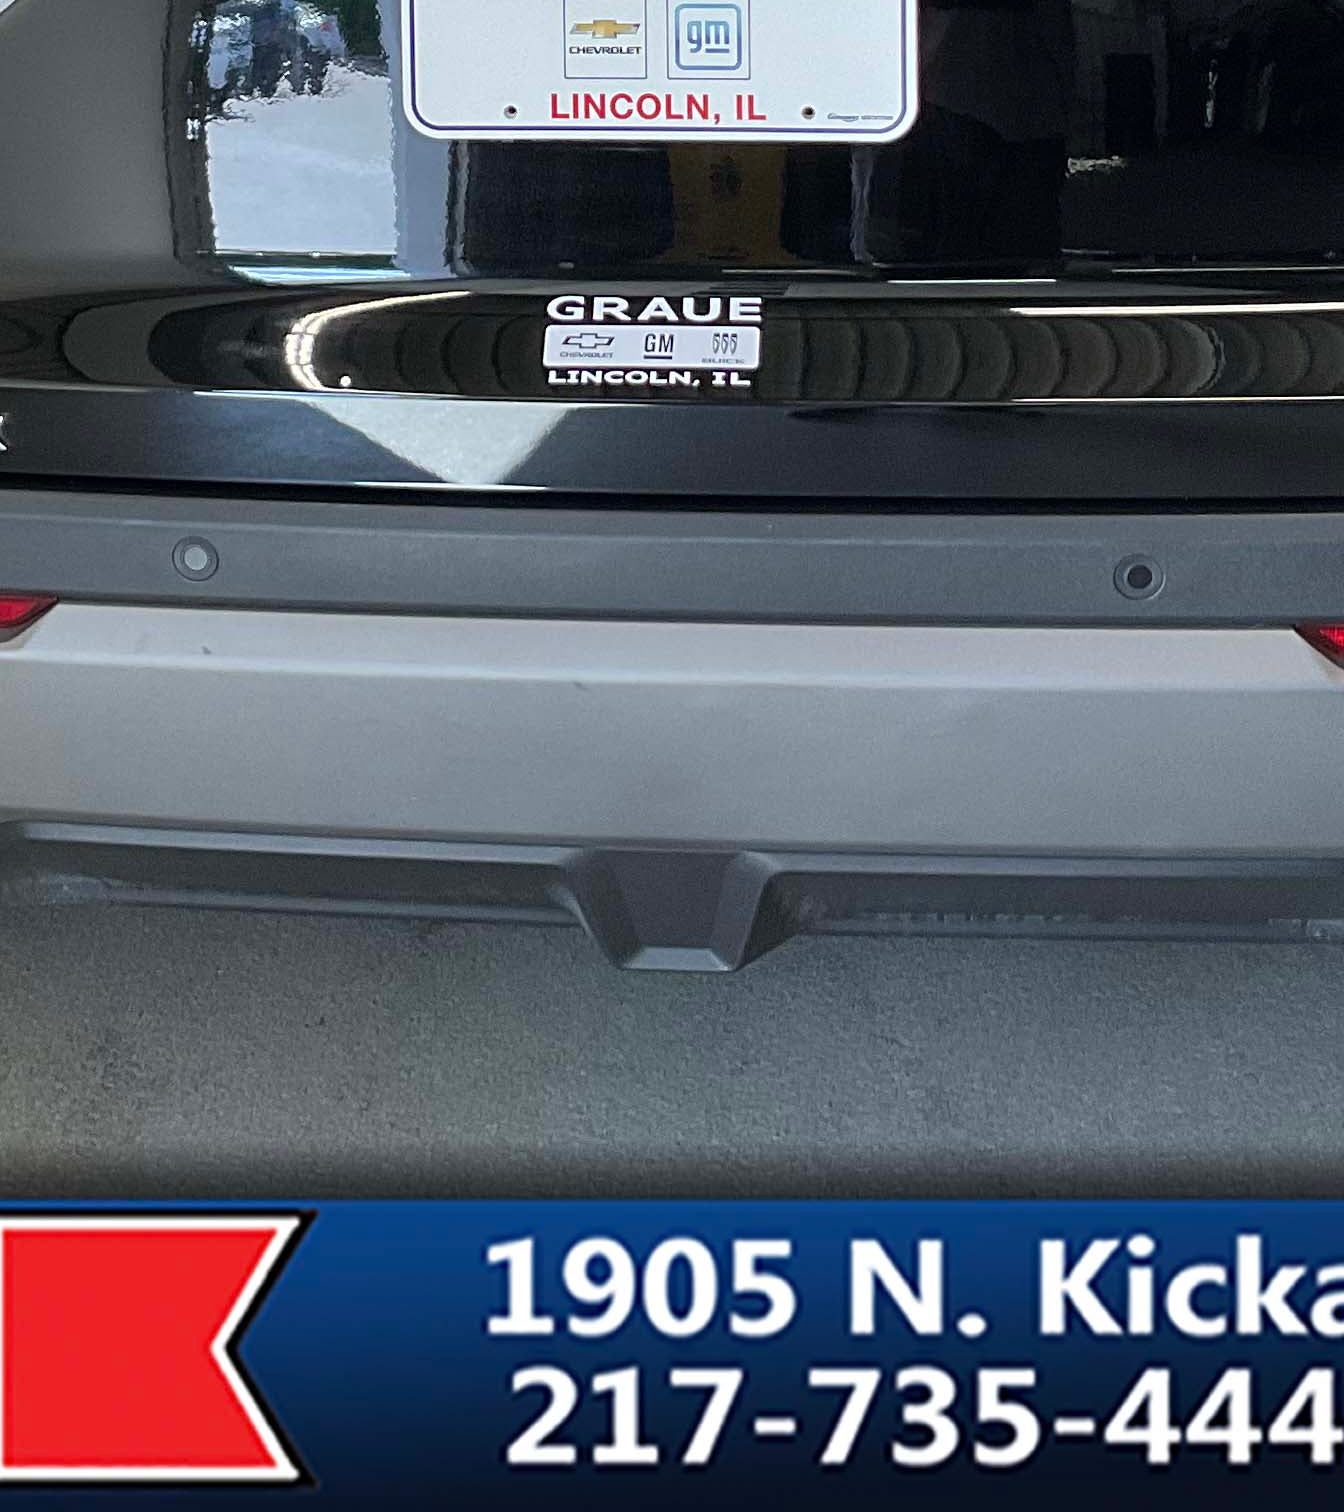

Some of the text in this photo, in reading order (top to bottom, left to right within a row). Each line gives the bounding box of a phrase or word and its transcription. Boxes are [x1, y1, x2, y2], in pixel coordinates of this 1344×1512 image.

[686, 20, 731, 54] gm
[568, 45, 642, 55] CHEVROLET
[550, 93, 767, 125] LINCOLN, IL
[546, 295, 762, 322] GRAUE
[643, 333, 674, 353] GM
[547, 370, 751, 387] LINCOLN, IL
